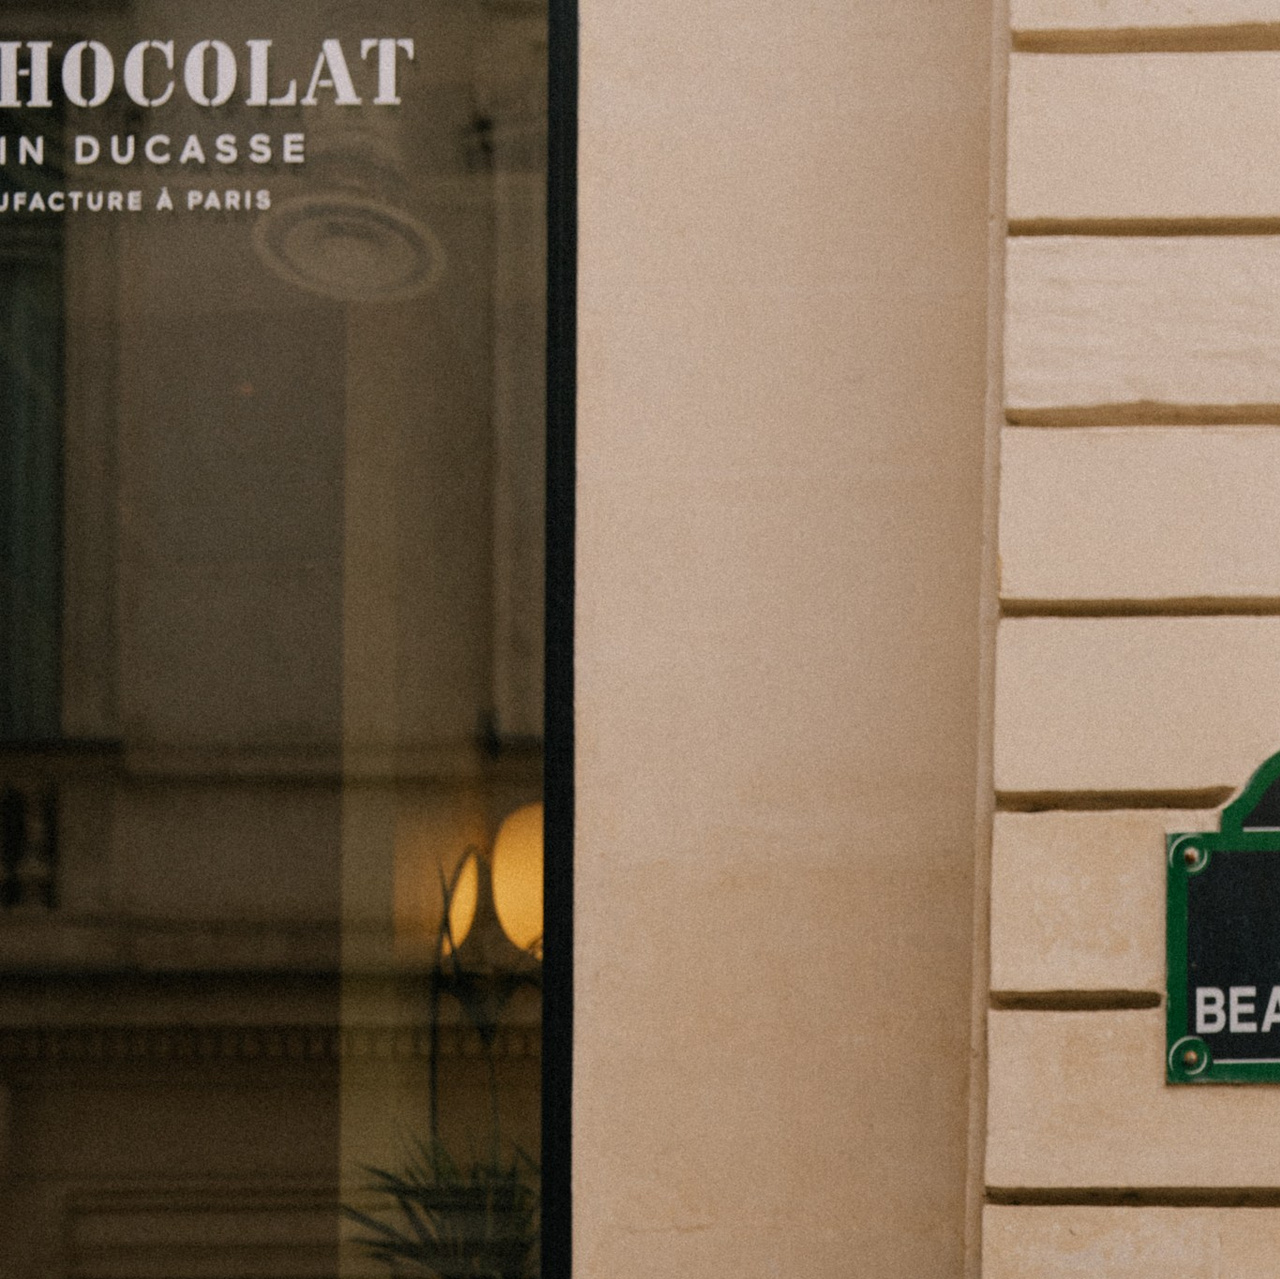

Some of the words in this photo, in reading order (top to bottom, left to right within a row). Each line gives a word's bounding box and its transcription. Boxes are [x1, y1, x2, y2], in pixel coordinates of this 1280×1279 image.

[0, 38, 415, 108] HOCOLAT
[75, 133, 305, 165] DUCASSE
[156, 187, 174, 212] À
[188, 190, 271, 211] PARIS
